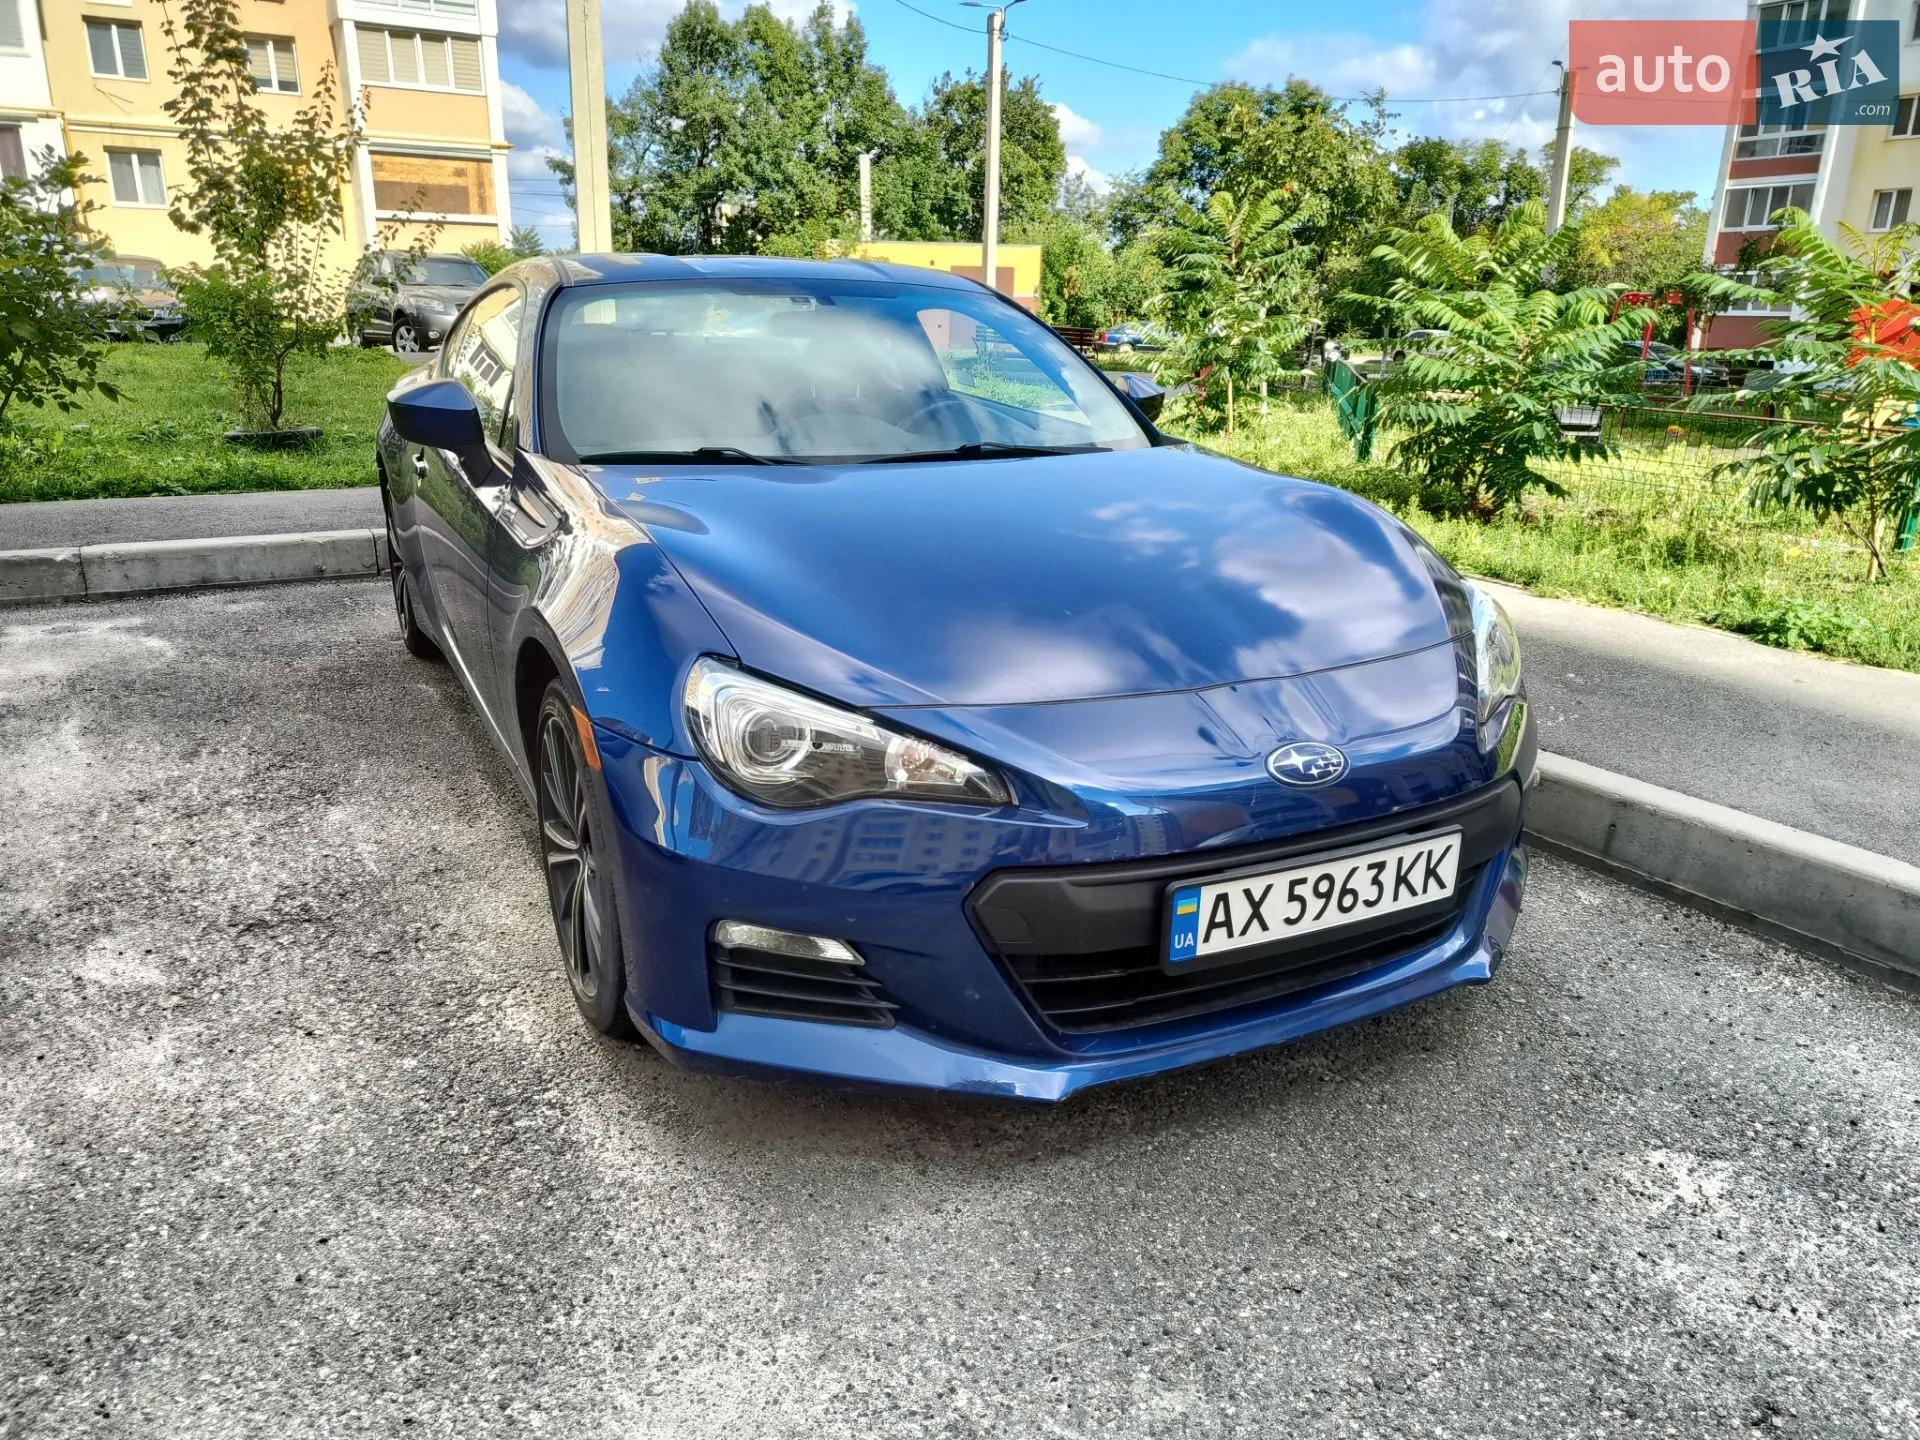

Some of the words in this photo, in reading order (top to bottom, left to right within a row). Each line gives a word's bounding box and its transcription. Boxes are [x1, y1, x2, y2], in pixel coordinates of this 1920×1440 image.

[1202, 883, 1274, 943] AX
[1283, 859, 1388, 926] 5963
[1393, 844, 1453, 902] KK
[1174, 932, 1194, 949] UA
